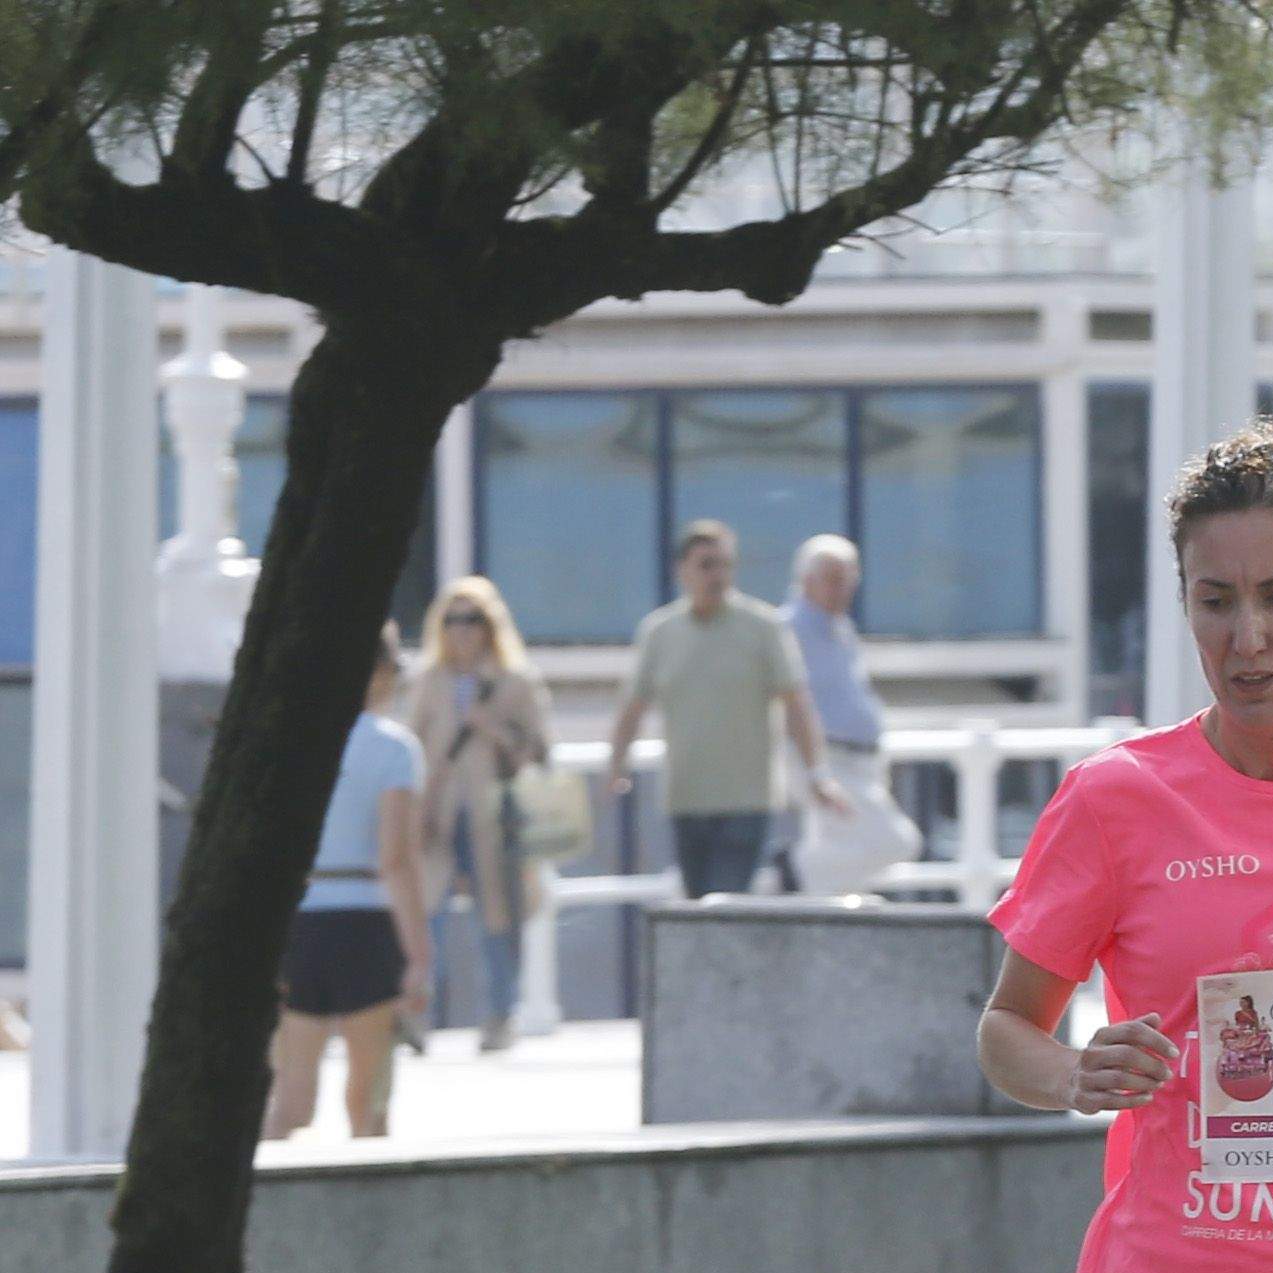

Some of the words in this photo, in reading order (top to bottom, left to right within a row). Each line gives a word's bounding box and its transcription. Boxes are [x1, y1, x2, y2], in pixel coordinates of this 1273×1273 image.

[1166, 854, 1260, 882] OYSHO
[1180, 1225, 1226, 1239] CARRERA
[1227, 1229, 1245, 1241] DE
[1247, 1230, 1262, 1241] LA
